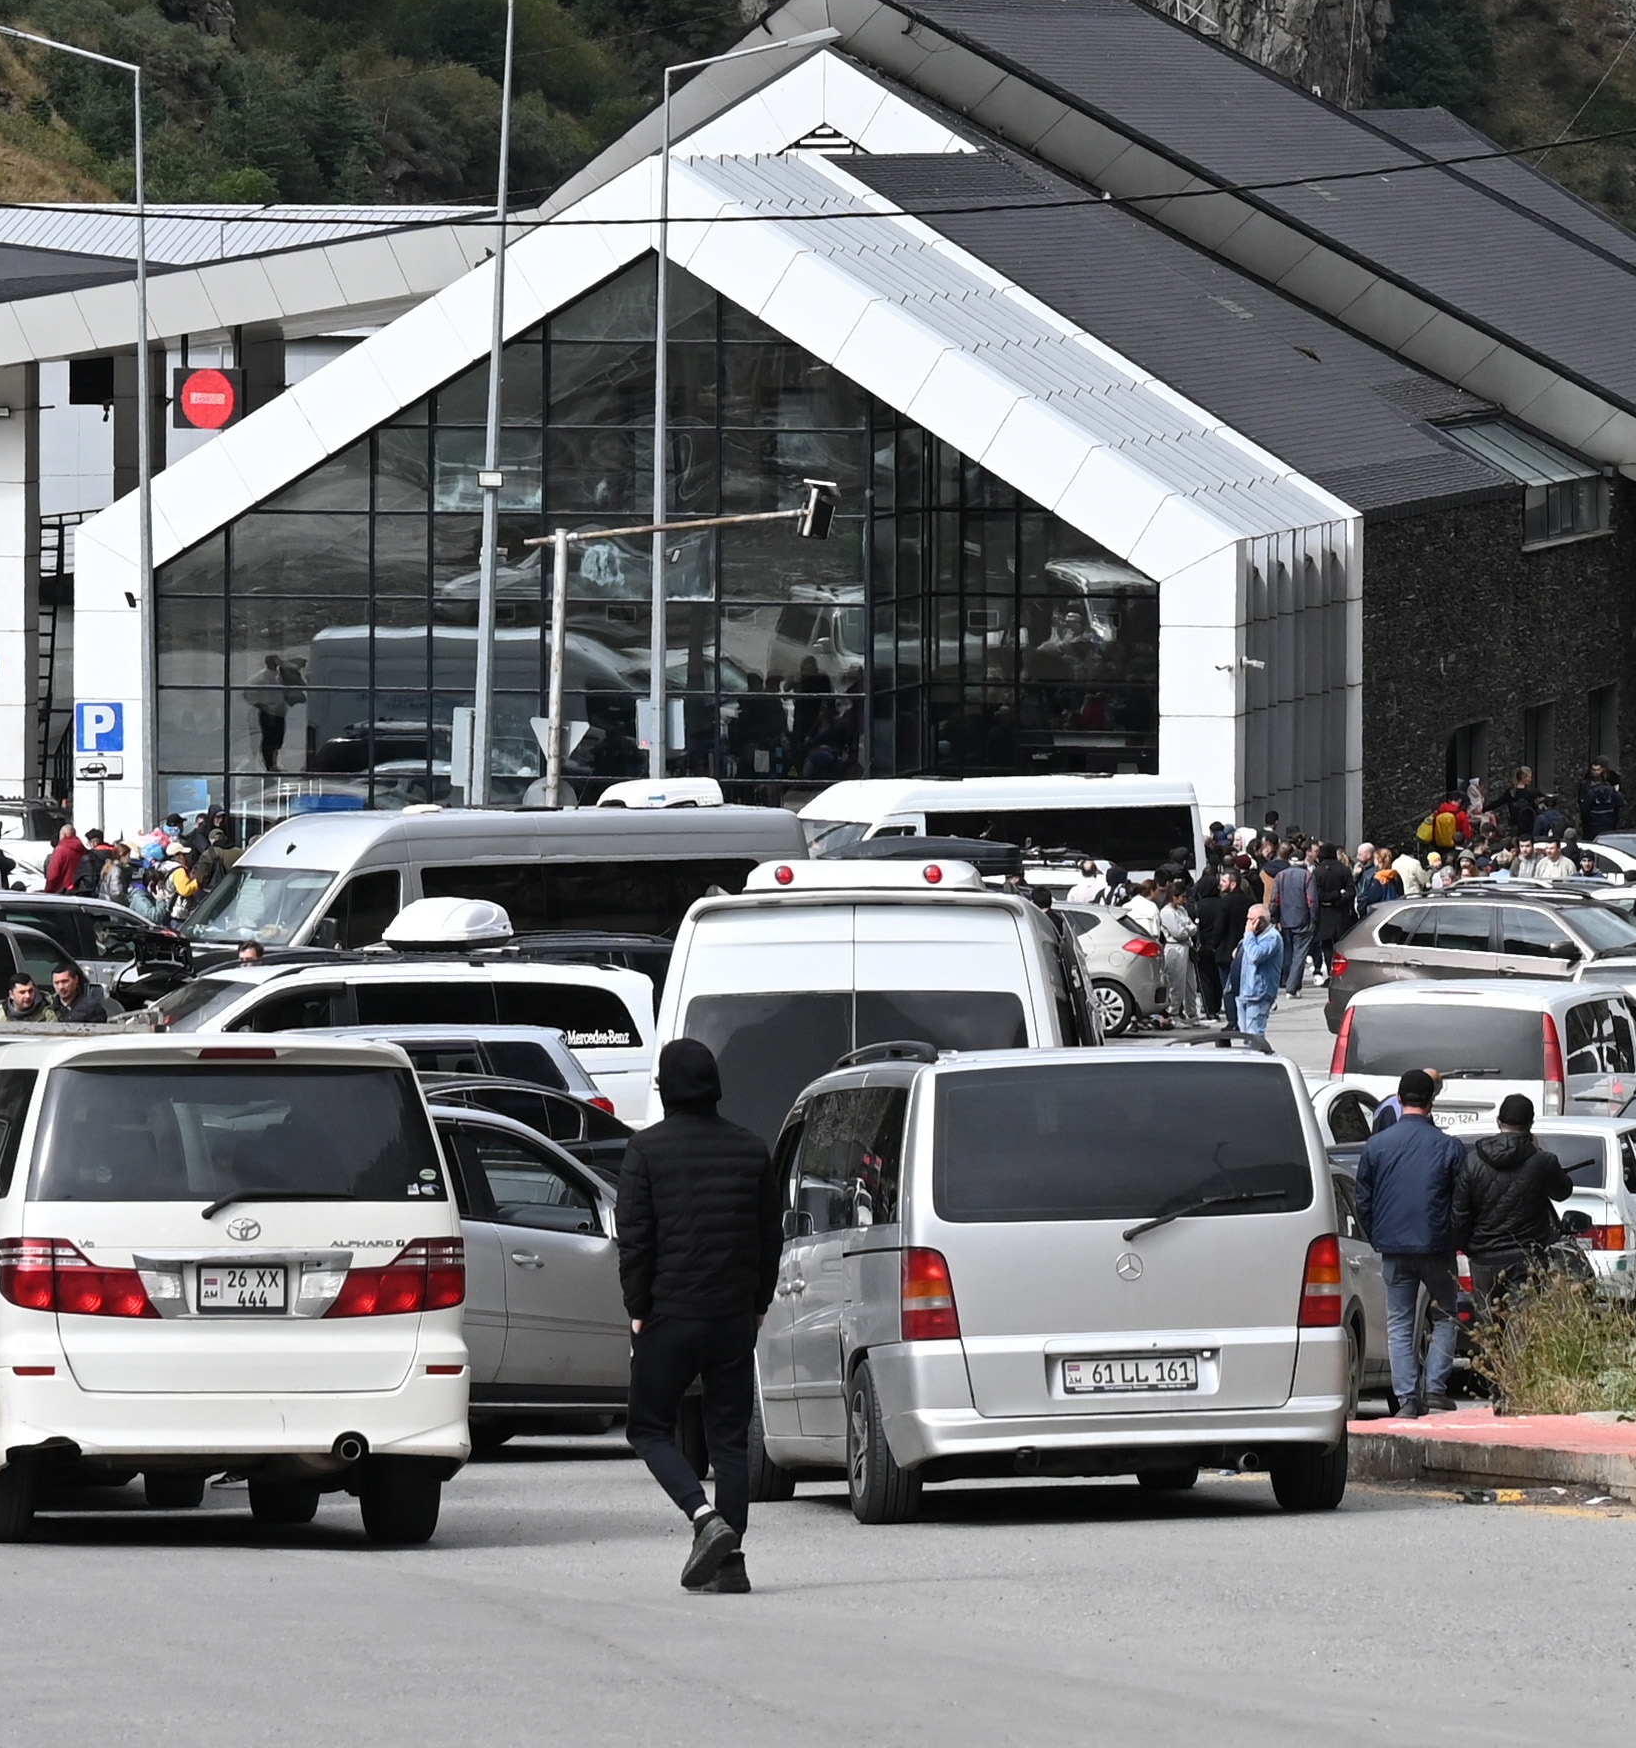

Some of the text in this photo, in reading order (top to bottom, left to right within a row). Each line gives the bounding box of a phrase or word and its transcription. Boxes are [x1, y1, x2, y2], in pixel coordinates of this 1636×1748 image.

[83, 705, 116, 750] P
[567, 1029, 630, 1045] Mercedes-Benz
[330, 1239, 393, 1248] ALPHARD
[228, 1270, 279, 1288] 26 XX
[203, 1290, 218, 1300] AM
[238, 1290, 268, 1308] 444
[1068, 1376, 1083, 1385] AM
[1092, 1361, 1190, 1384] 61 LL 161
